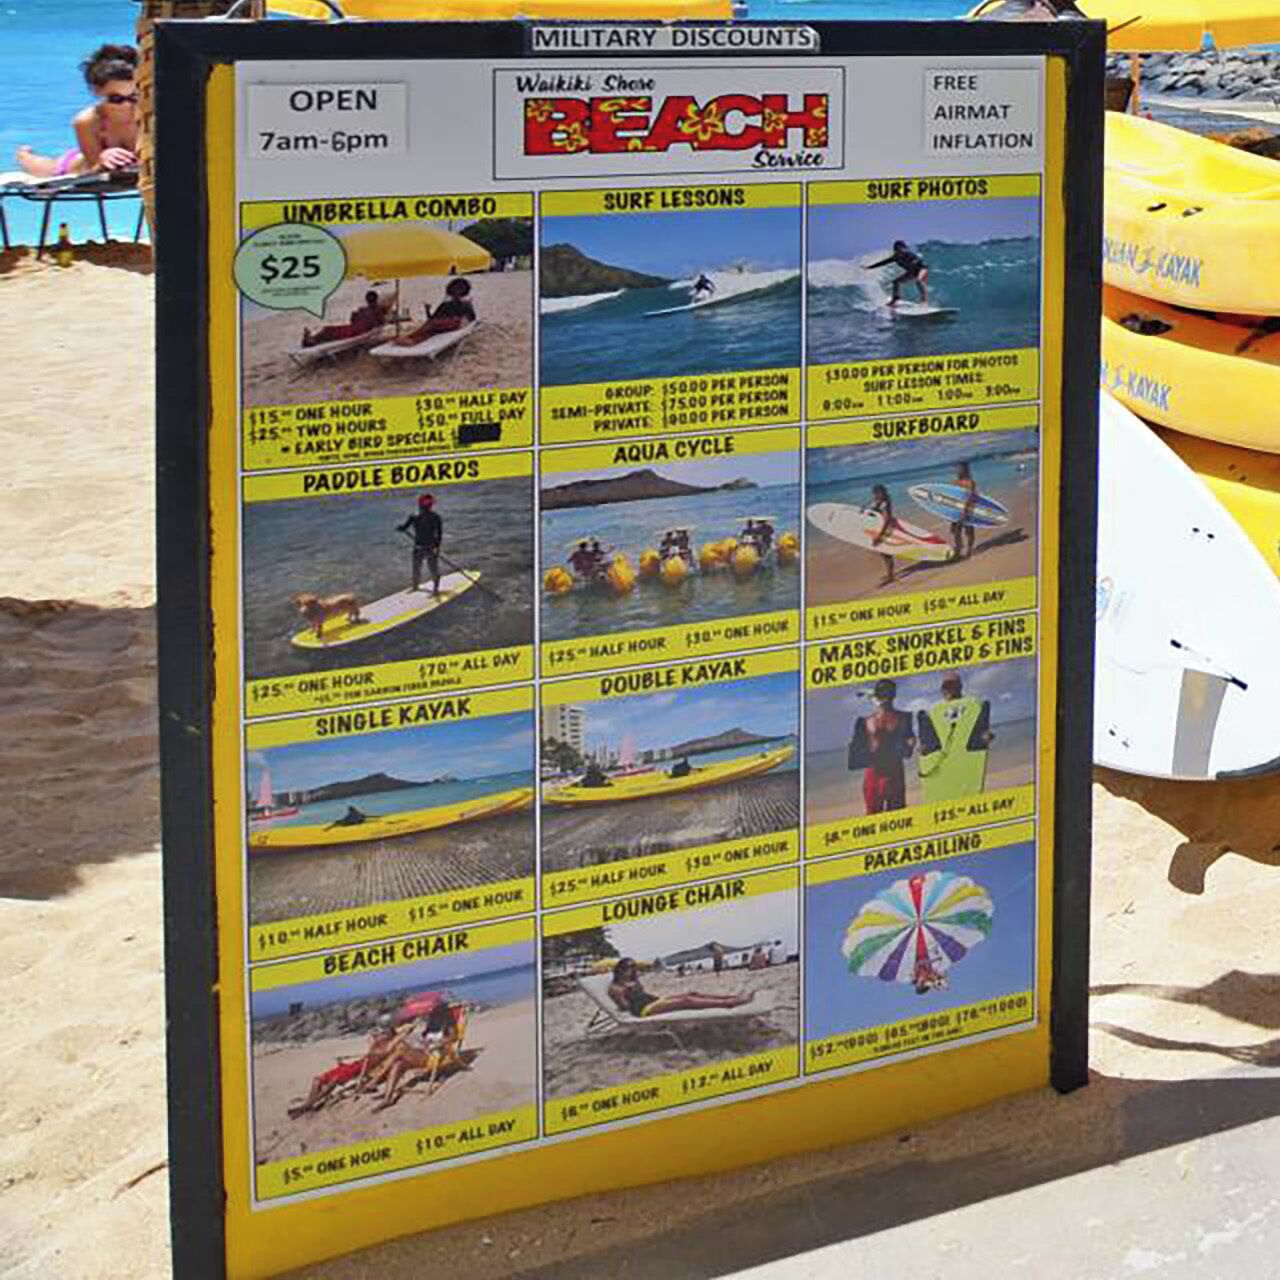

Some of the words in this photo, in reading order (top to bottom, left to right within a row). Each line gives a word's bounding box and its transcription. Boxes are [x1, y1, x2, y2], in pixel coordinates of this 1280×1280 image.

[535, 29, 657, 48] MILITARY
[671, 28, 812, 47] DISCOUNTS
[516, 75, 593, 93] Waikiki
[602, 74, 656, 91] Shore
[933, 75, 978, 90] FREE
[290, 89, 378, 112] OPEN
[934, 105, 1011, 120] AIRMAT
[524, 94, 829, 156] BEACH
[260, 131, 388, 153] 7am-6pm
[933, 133, 1034, 149] INFLATION
[751, 150, 825, 168] Service
[604, 191, 656, 210] SURF
[661, 188, 746, 208] LESSONS
[867, 183, 912, 199] SURF
[918, 179, 988, 197] PHOTOS
[283, 201, 408, 222] UMBRELLA
[415, 198, 497, 217] COMBO
[260, 254, 321, 285] $25
[872, 364, 895, 377] PER
[898, 361, 944, 375] PERSON
[947, 358, 969, 370] FOR
[972, 355, 1019, 368] PHOTOS
[712, 377, 736, 391] PER
[740, 373, 788, 388] PERSON
[864, 379, 895, 393] SURF
[897, 376, 941, 389] LESSON
[1127, 370, 1172, 411] KAYAK
[459, 393, 497, 407] HALF
[500, 391, 528, 405] DAY
[711, 393, 735, 406] PER
[739, 390, 788, 403] PERSON
[296, 406, 327, 421] ONE
[331, 403, 373, 418] HOUR
[461, 409, 494, 423] FULL
[500, 406, 527, 420] DAY
[711, 409, 735, 422] PER
[739, 405, 789, 419] PERSON
[298, 423, 332, 437] TWO
[336, 419, 387, 433] HOURS
[873, 413, 980, 439] SURFBOARD
[295, 439, 346, 455] EARLY
[349, 434, 383, 450] BIRD
[387, 431, 446, 447] SPECIAL
[613, 441, 669, 463] AQUA
[675, 436, 735, 457] CYCLE
[303, 469, 385, 492] PADDLE
[391, 460, 479, 485] BOARDS
[959, 593, 979, 607] ALL
[983, 590, 1006, 603] DAY
[850, 607, 874, 621] ONE
[877, 603, 911, 618] HOUR
[724, 625, 751, 639] ONE
[754, 620, 789, 636] HOUR
[589, 642, 624, 658] HALF
[628, 637, 667, 652] HOUR
[819, 640, 881, 665] MASK,
[887, 628, 966, 654] SNORKEL
[971, 624, 984, 639] &
[988, 618, 1026, 637] FINS
[463, 657, 487, 672] ALL
[493, 653, 521, 668] DAY
[811, 665, 837, 685] OR
[842, 655, 908, 680] BOOGIE
[913, 646, 973, 668] BOARD
[979, 641, 991, 657] &
[995, 636, 1033, 656] FINS
[298, 678, 329, 694] ONE
[332, 672, 375, 688] HOUR
[601, 667, 676, 696] DOUBLE
[682, 658, 746, 685] KAYAK
[316, 708, 393, 737] SINGLE
[400, 697, 471, 725] KAYAK
[968, 802, 989, 817] ALL
[853, 824, 877, 840] ONE
[879, 817, 913, 833] HOUR
[724, 847, 751, 863] ONE
[753, 840, 790, 858] HOUR
[863, 832, 982, 871] PARASAILING
[591, 869, 625, 887] HALF
[629, 862, 668, 881] HOUR
[452, 896, 481, 913] ONE
[484, 888, 524, 908] HOUR
[602, 892, 680, 922] LOUNGE
[685, 878, 746, 906] CHAIR
[303, 920, 341, 940] HALF
[346, 913, 388, 933] HOUR
[323, 945, 396, 975] BEACH
[402, 930, 469, 960] CHAIR
[721, 1066, 746, 1084] ALL
[749, 1059, 774, 1078] DAY
[592, 1095, 619, 1113] ONE
[622, 1087, 660, 1106] HOUR
[458, 1126, 485, 1144] ALL
[488, 1118, 516, 1138] DAY
[316, 1157, 346, 1175] ONE
[350, 1146, 392, 1167] HOUR
